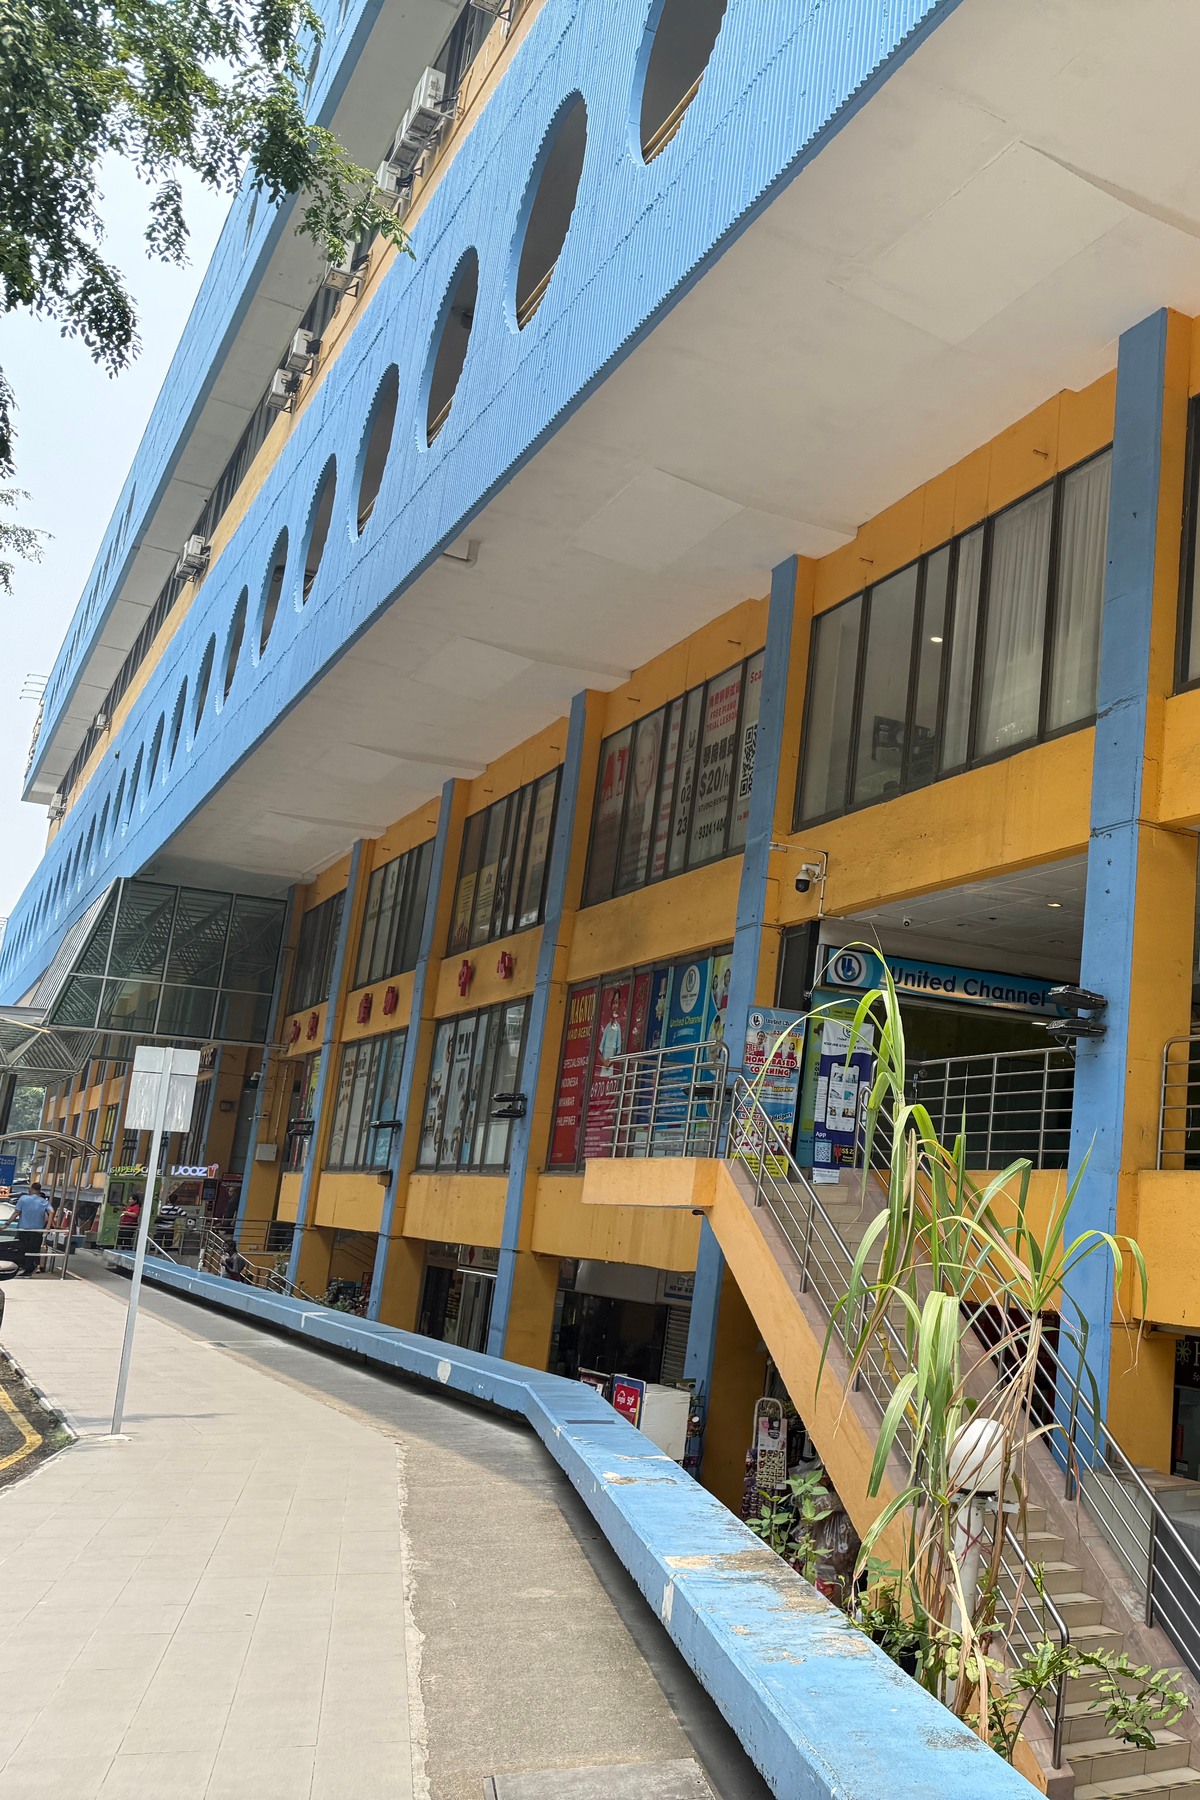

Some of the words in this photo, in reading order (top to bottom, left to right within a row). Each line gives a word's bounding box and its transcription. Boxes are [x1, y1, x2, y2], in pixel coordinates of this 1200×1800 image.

[890, 964, 956, 993] United
[963, 977, 1046, 1007] Channel
[749, 1065, 790, 1077] COCHING
[170, 1165, 208, 1177] IJOOZ
